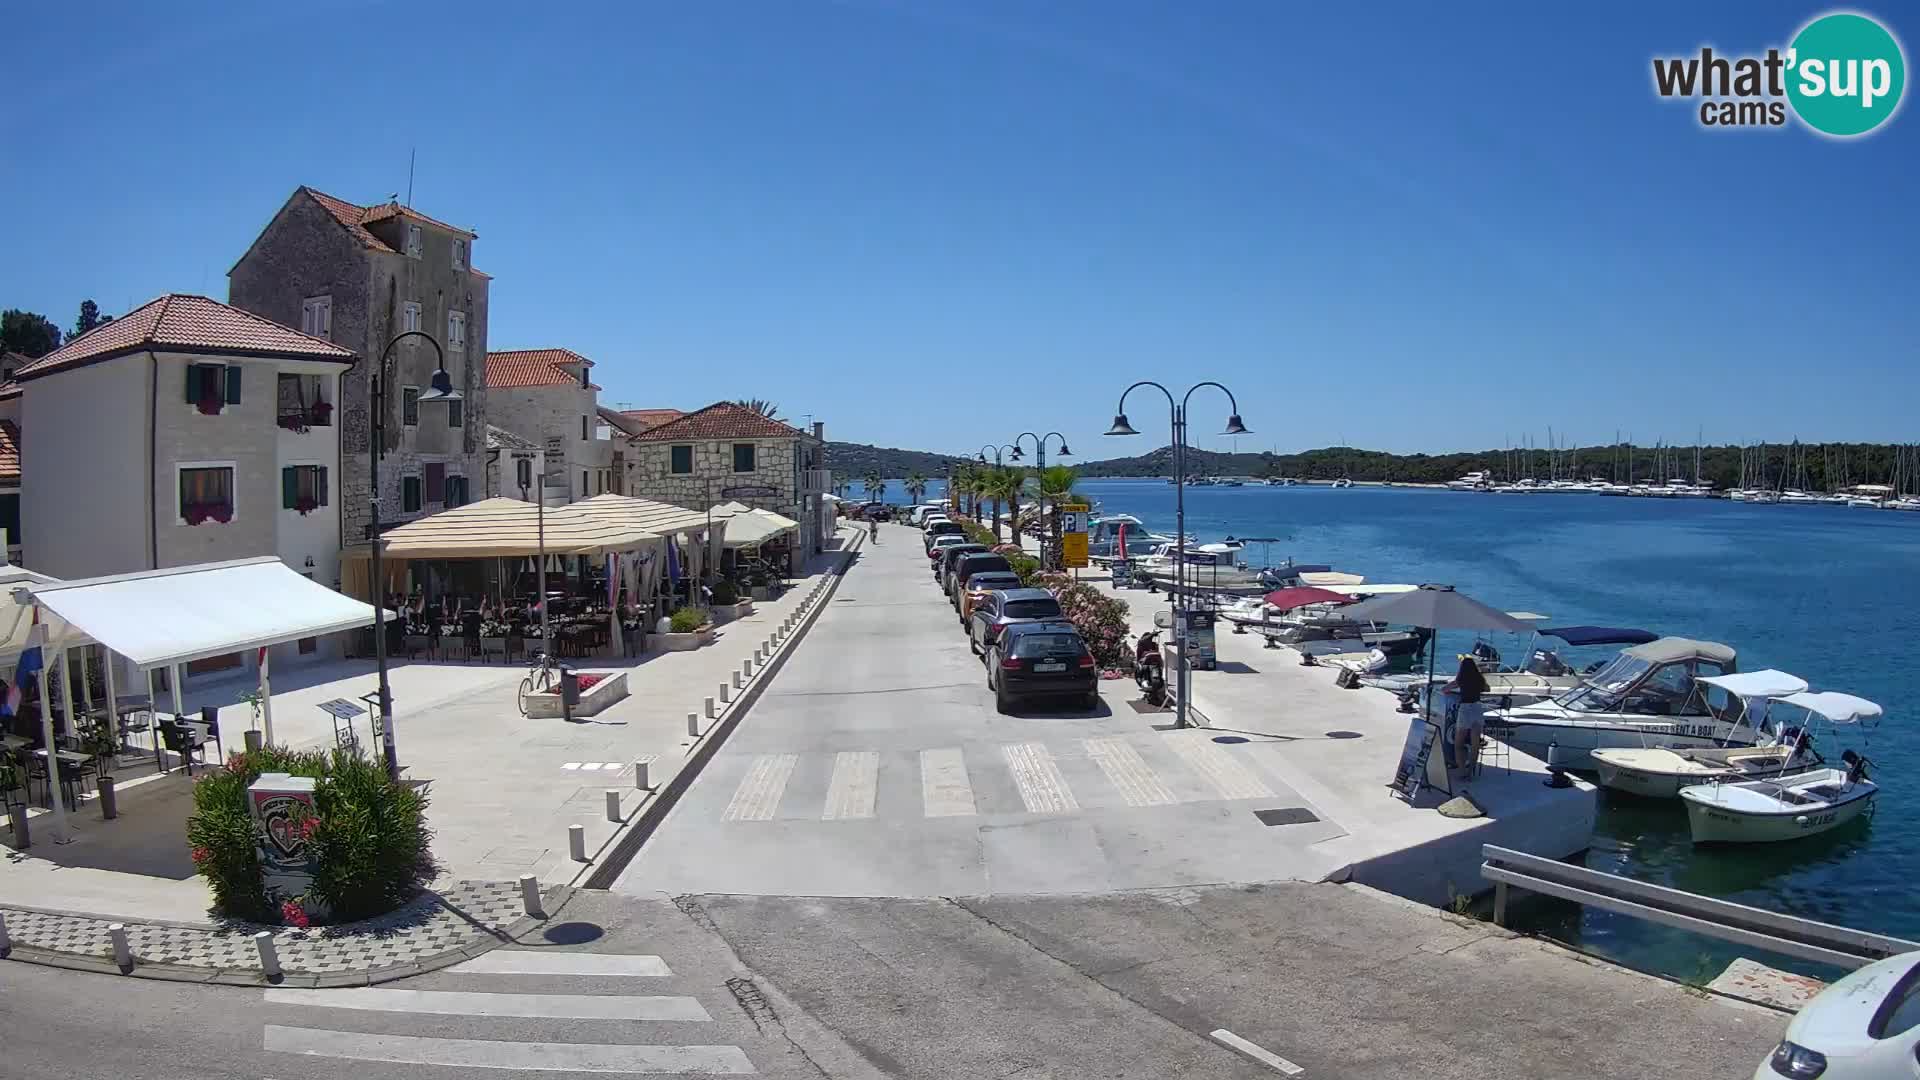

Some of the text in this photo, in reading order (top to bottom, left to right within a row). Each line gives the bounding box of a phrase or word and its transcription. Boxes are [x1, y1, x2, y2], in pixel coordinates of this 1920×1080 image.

[1065, 514, 1075, 531] P
[1670, 723, 1690, 736] RENT
[1691, 725, 1697, 736] A
[1698, 725, 1717, 737] BOAT
